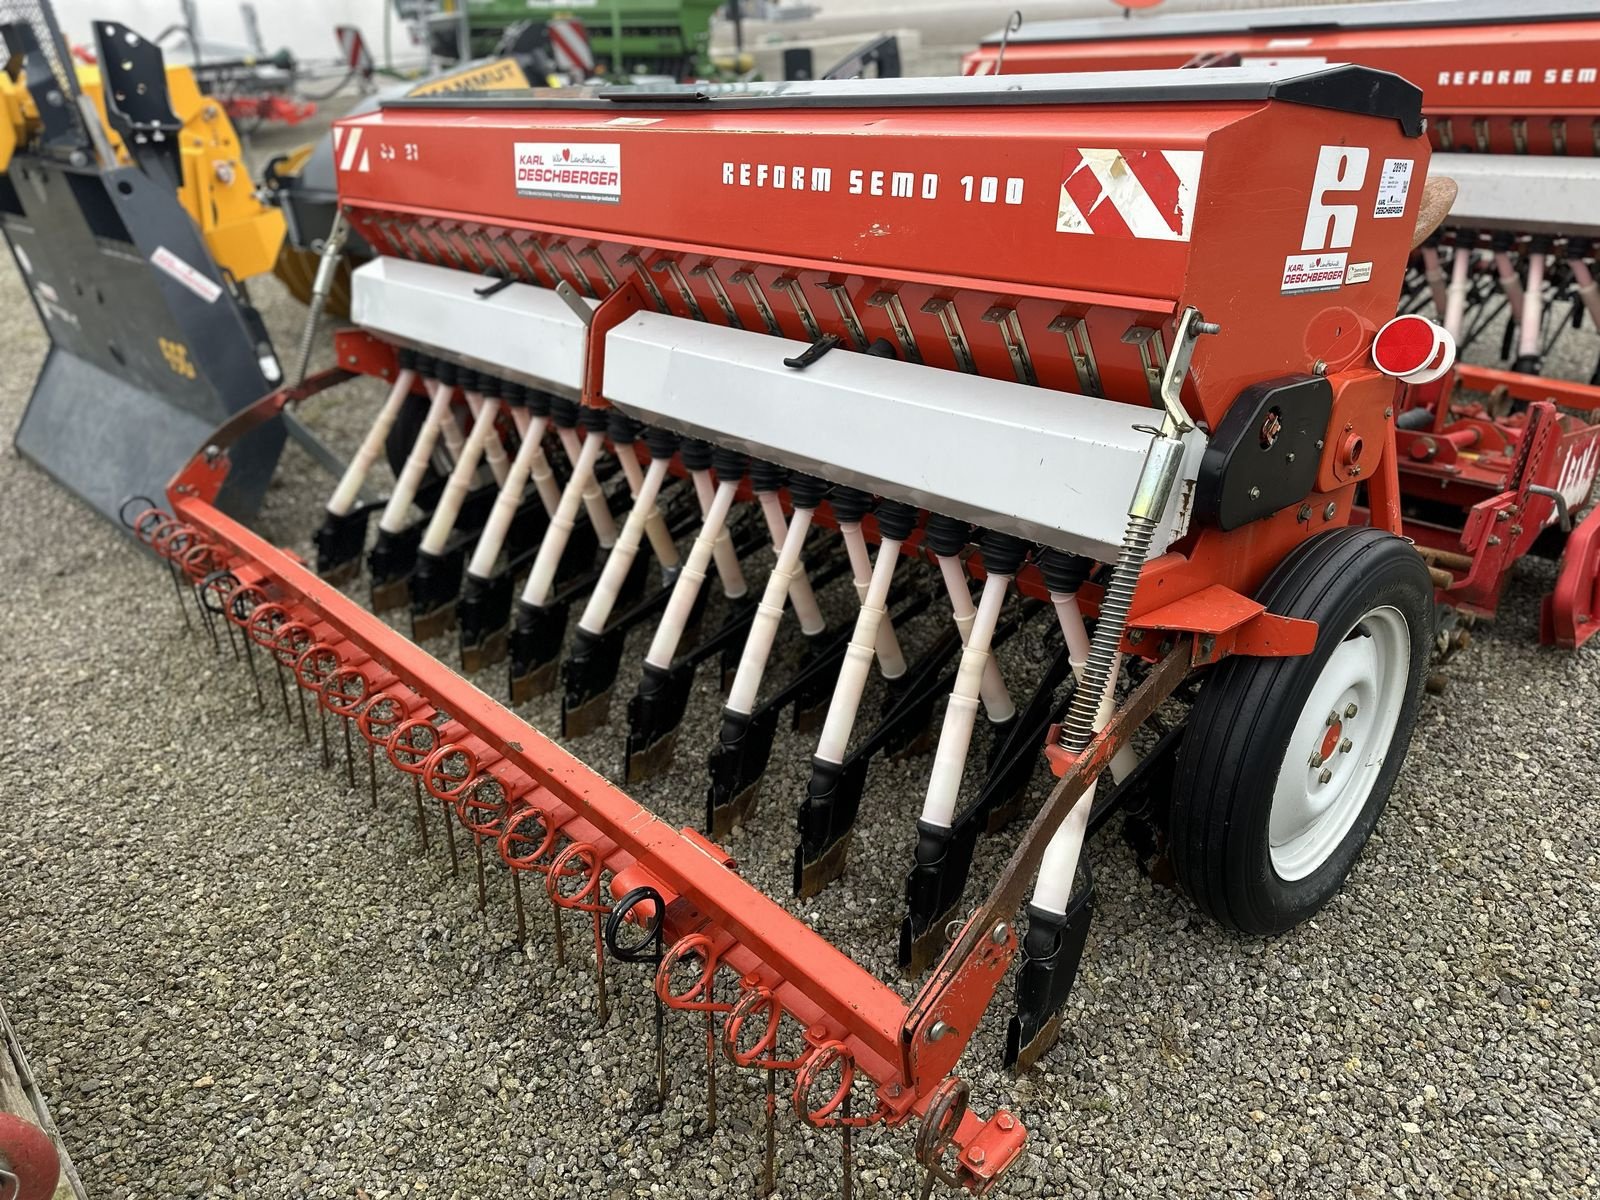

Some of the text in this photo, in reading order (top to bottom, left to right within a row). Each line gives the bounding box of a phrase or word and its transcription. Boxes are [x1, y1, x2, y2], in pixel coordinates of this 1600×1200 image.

[1437, 69, 1533, 85] REFORM
[519, 155, 545, 166] KARL
[518, 168, 619, 187] DESCHBERGER
[722, 161, 1025, 206] REFORM SEMO 100
[1287, 264, 1304, 273] KARL
[1283, 270, 1343, 285] DESCHBERGER
